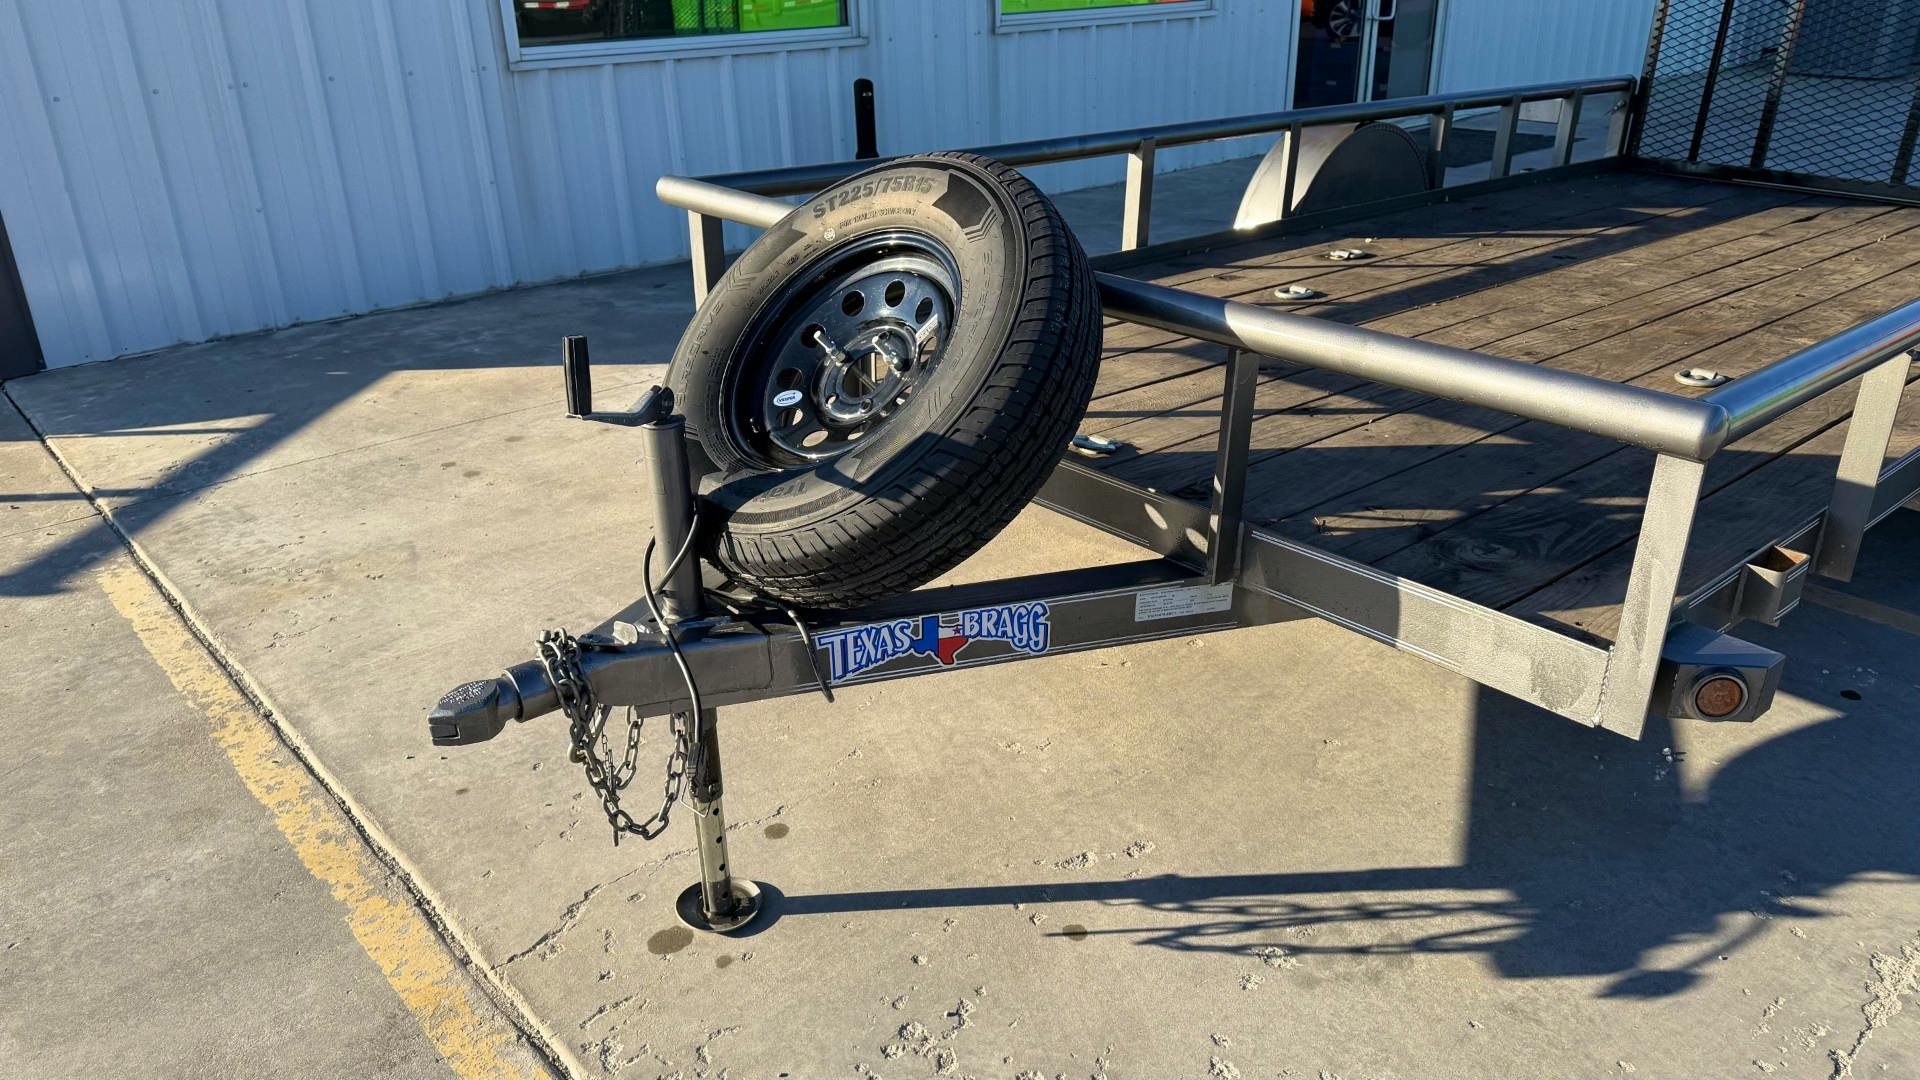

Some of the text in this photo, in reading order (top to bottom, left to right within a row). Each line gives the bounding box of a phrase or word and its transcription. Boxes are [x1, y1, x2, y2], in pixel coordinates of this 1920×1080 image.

[812, 175, 935, 219] ST225/75R15
[816, 602, 1048, 681] TEXAS BRAGG
